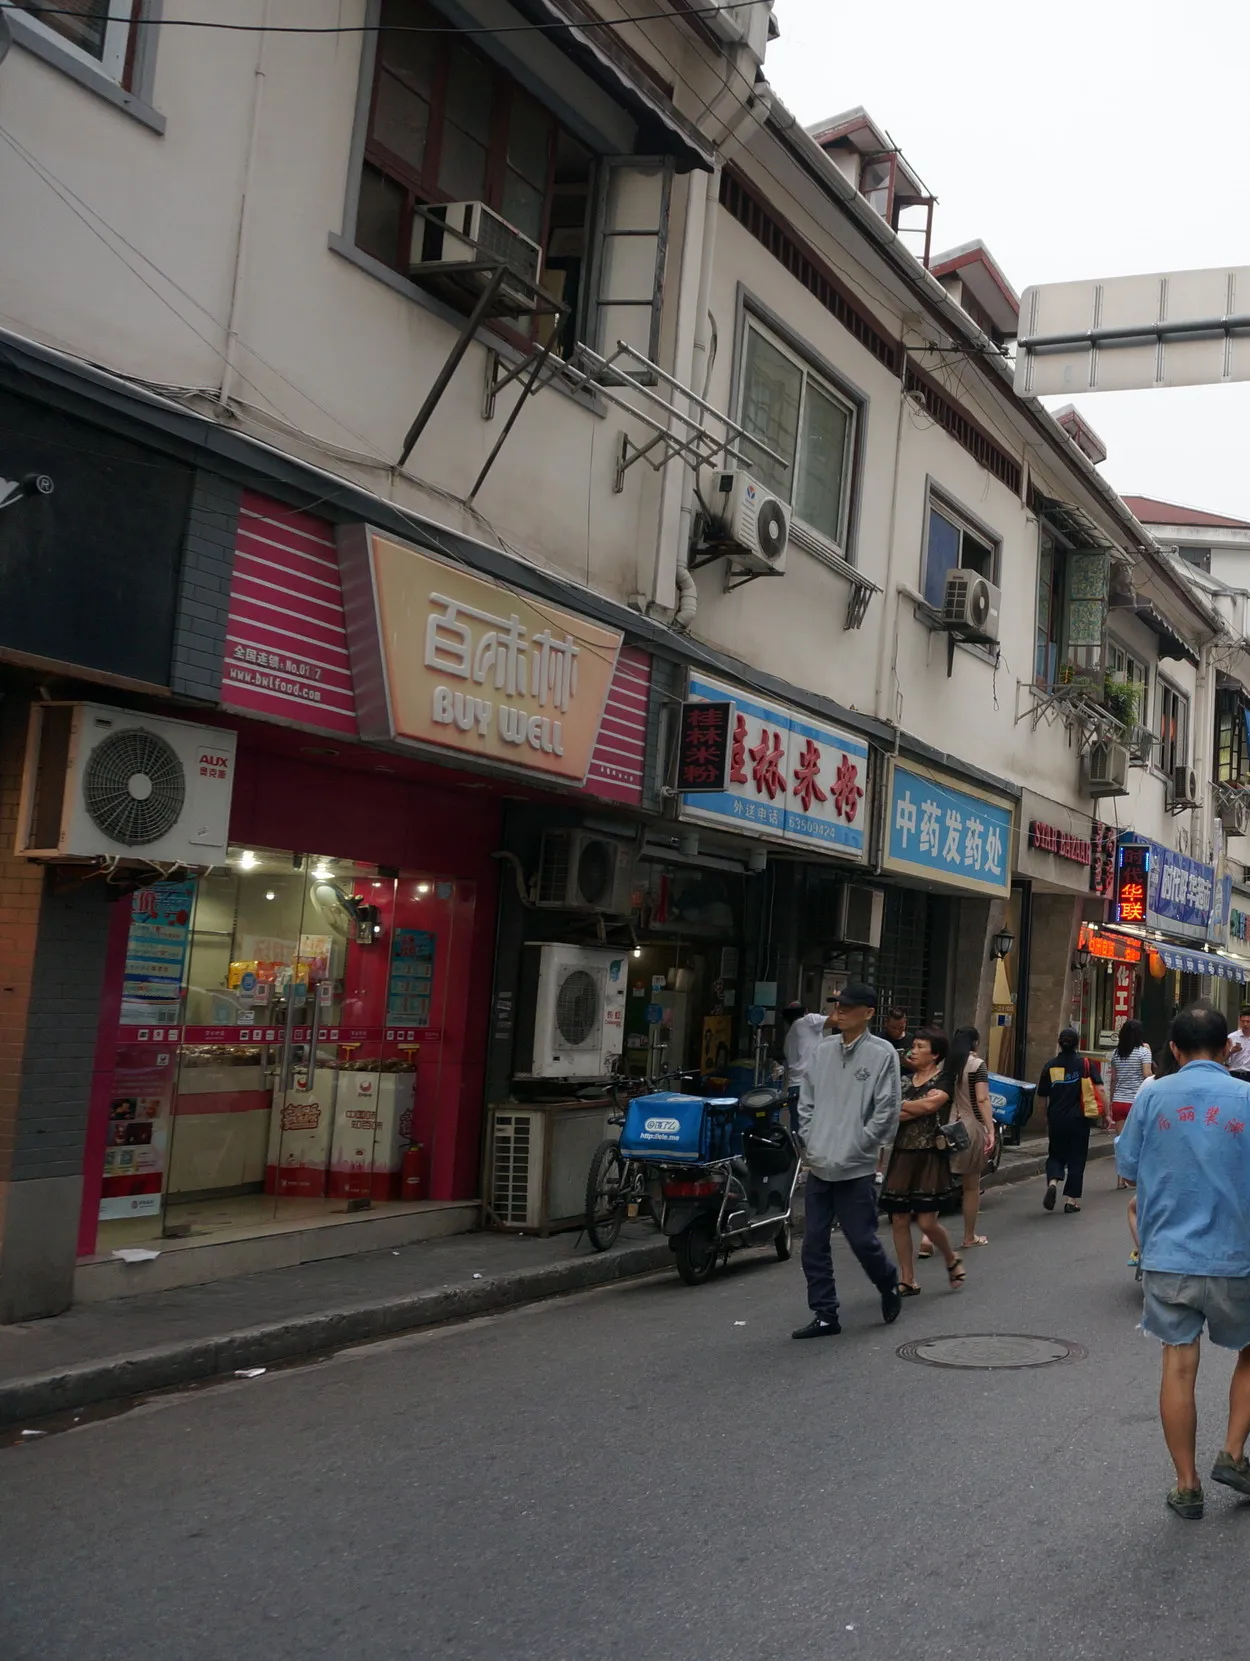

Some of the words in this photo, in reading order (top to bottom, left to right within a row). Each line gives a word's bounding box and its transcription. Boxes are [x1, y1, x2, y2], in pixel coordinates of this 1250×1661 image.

[432, 685, 492, 737] BUY
[498, 704, 564, 757] WELL
[683, 708, 724, 783] 桂林米粉
[199, 755, 228, 768] AUX
[733, 800, 778, 825] 外送电话
[789, 816, 835, 838] 63509424
[896, 790, 1002, 876] 中药发药处
[1034, 821, 1058, 853] STAR
[1059, 830, 1092, 865] BAZAAR
